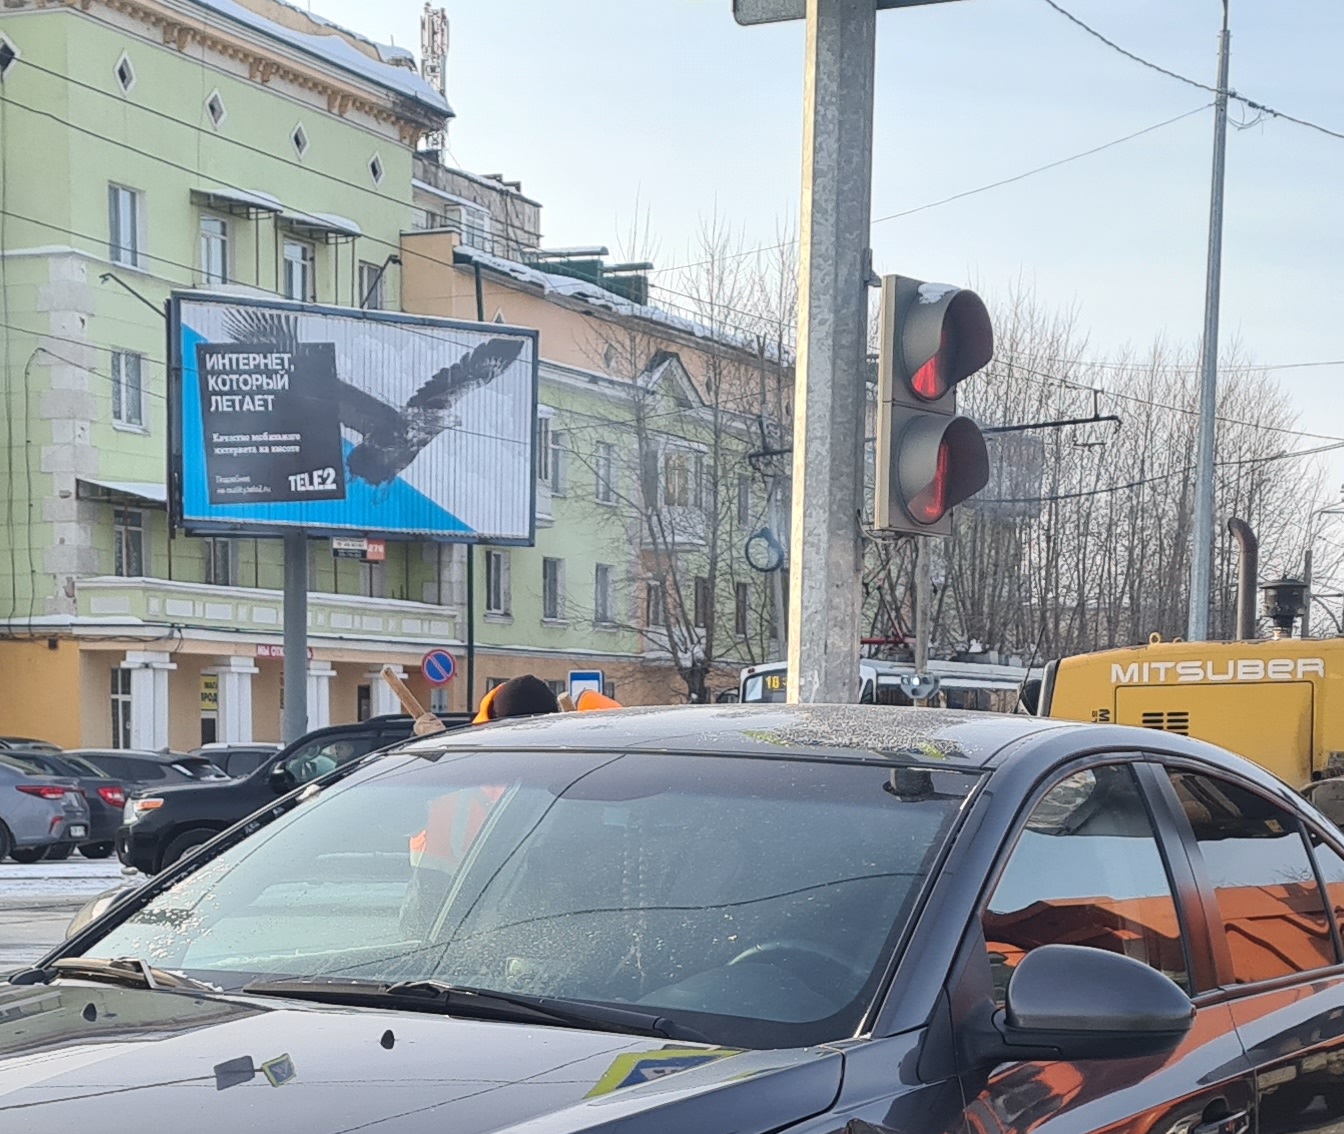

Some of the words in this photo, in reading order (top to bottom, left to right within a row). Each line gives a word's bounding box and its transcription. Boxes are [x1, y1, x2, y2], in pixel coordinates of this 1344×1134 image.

[206, 353, 295, 373] ИНТЕРНЕТ,
[208, 370, 290, 392] КОТОРЫЙ
[210, 394, 275, 413] ЛЕТАЕТ
[287, 467, 337, 492] TELE2
[1110, 657, 1326, 684] MITSUBER
